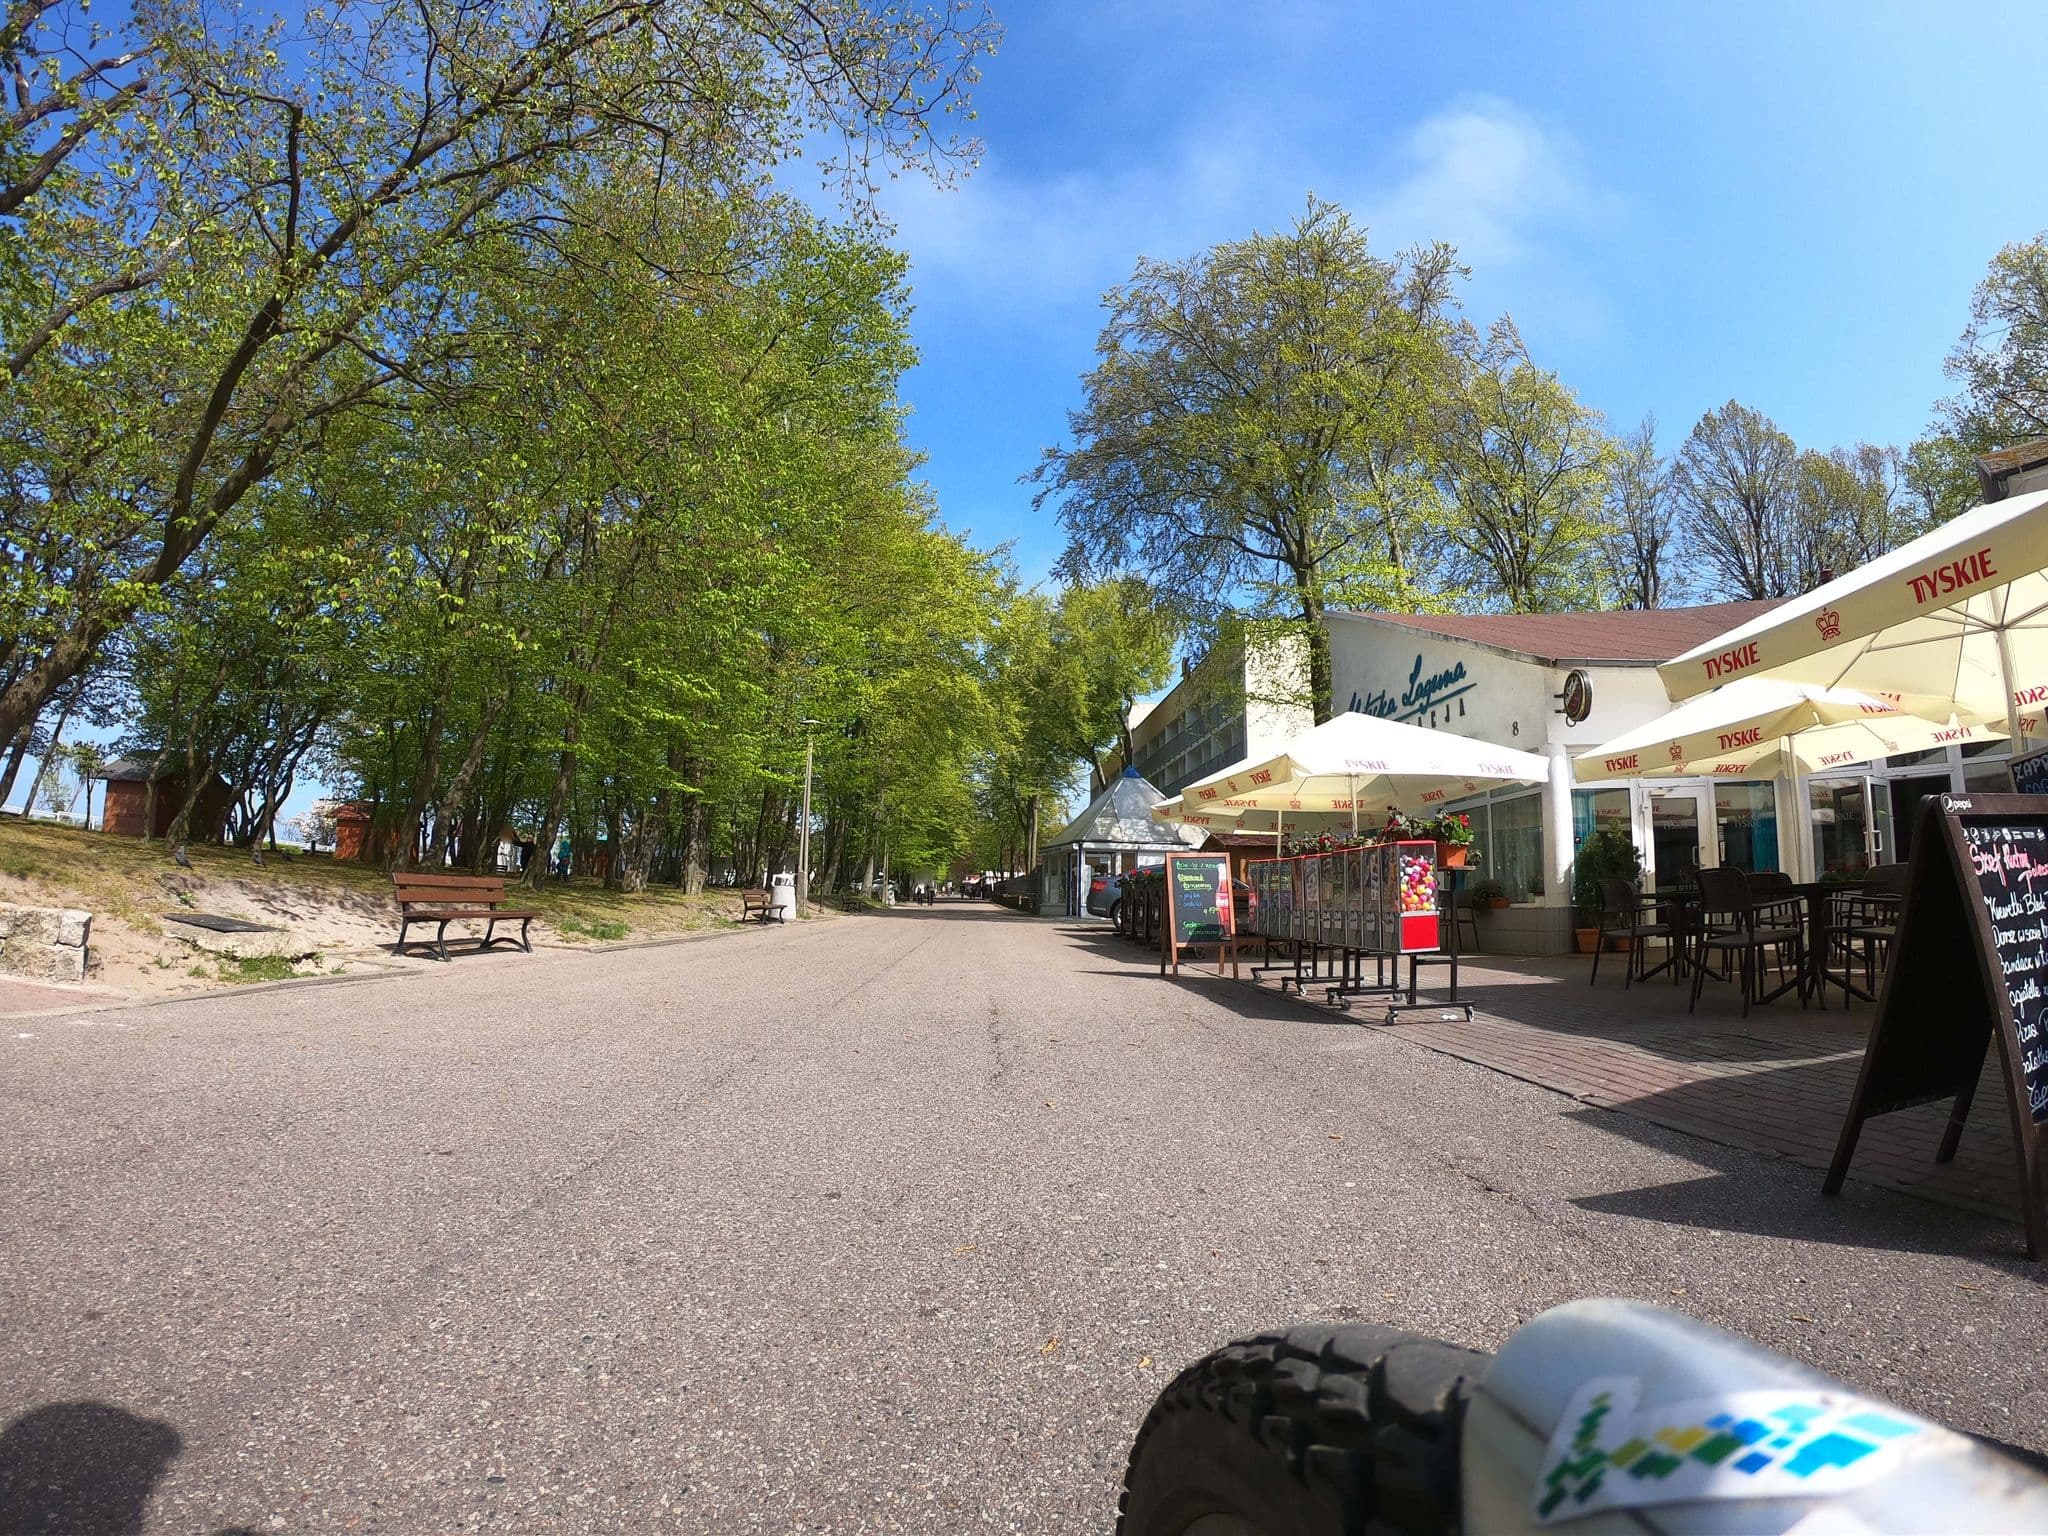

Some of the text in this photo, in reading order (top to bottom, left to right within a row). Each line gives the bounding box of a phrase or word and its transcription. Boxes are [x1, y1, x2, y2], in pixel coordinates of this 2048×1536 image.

[1907, 548, 1997, 604] TYSKIE
[1703, 641, 1760, 679] TYSKIE
[1402, 654, 1467, 714] Laguna
[1512, 721, 1519, 736] 8
[1717, 727, 1764, 750] TYSKIE
[1345, 759, 1391, 770] TYSKIE
[1479, 763, 1515, 775] TYSKIE
[1605, 754, 1639, 772] TYSKIE
[1953, 799, 1973, 810] pepsi
[1984, 891, 2024, 921] Krewetki
[1992, 924, 2017, 949] Dorsz
